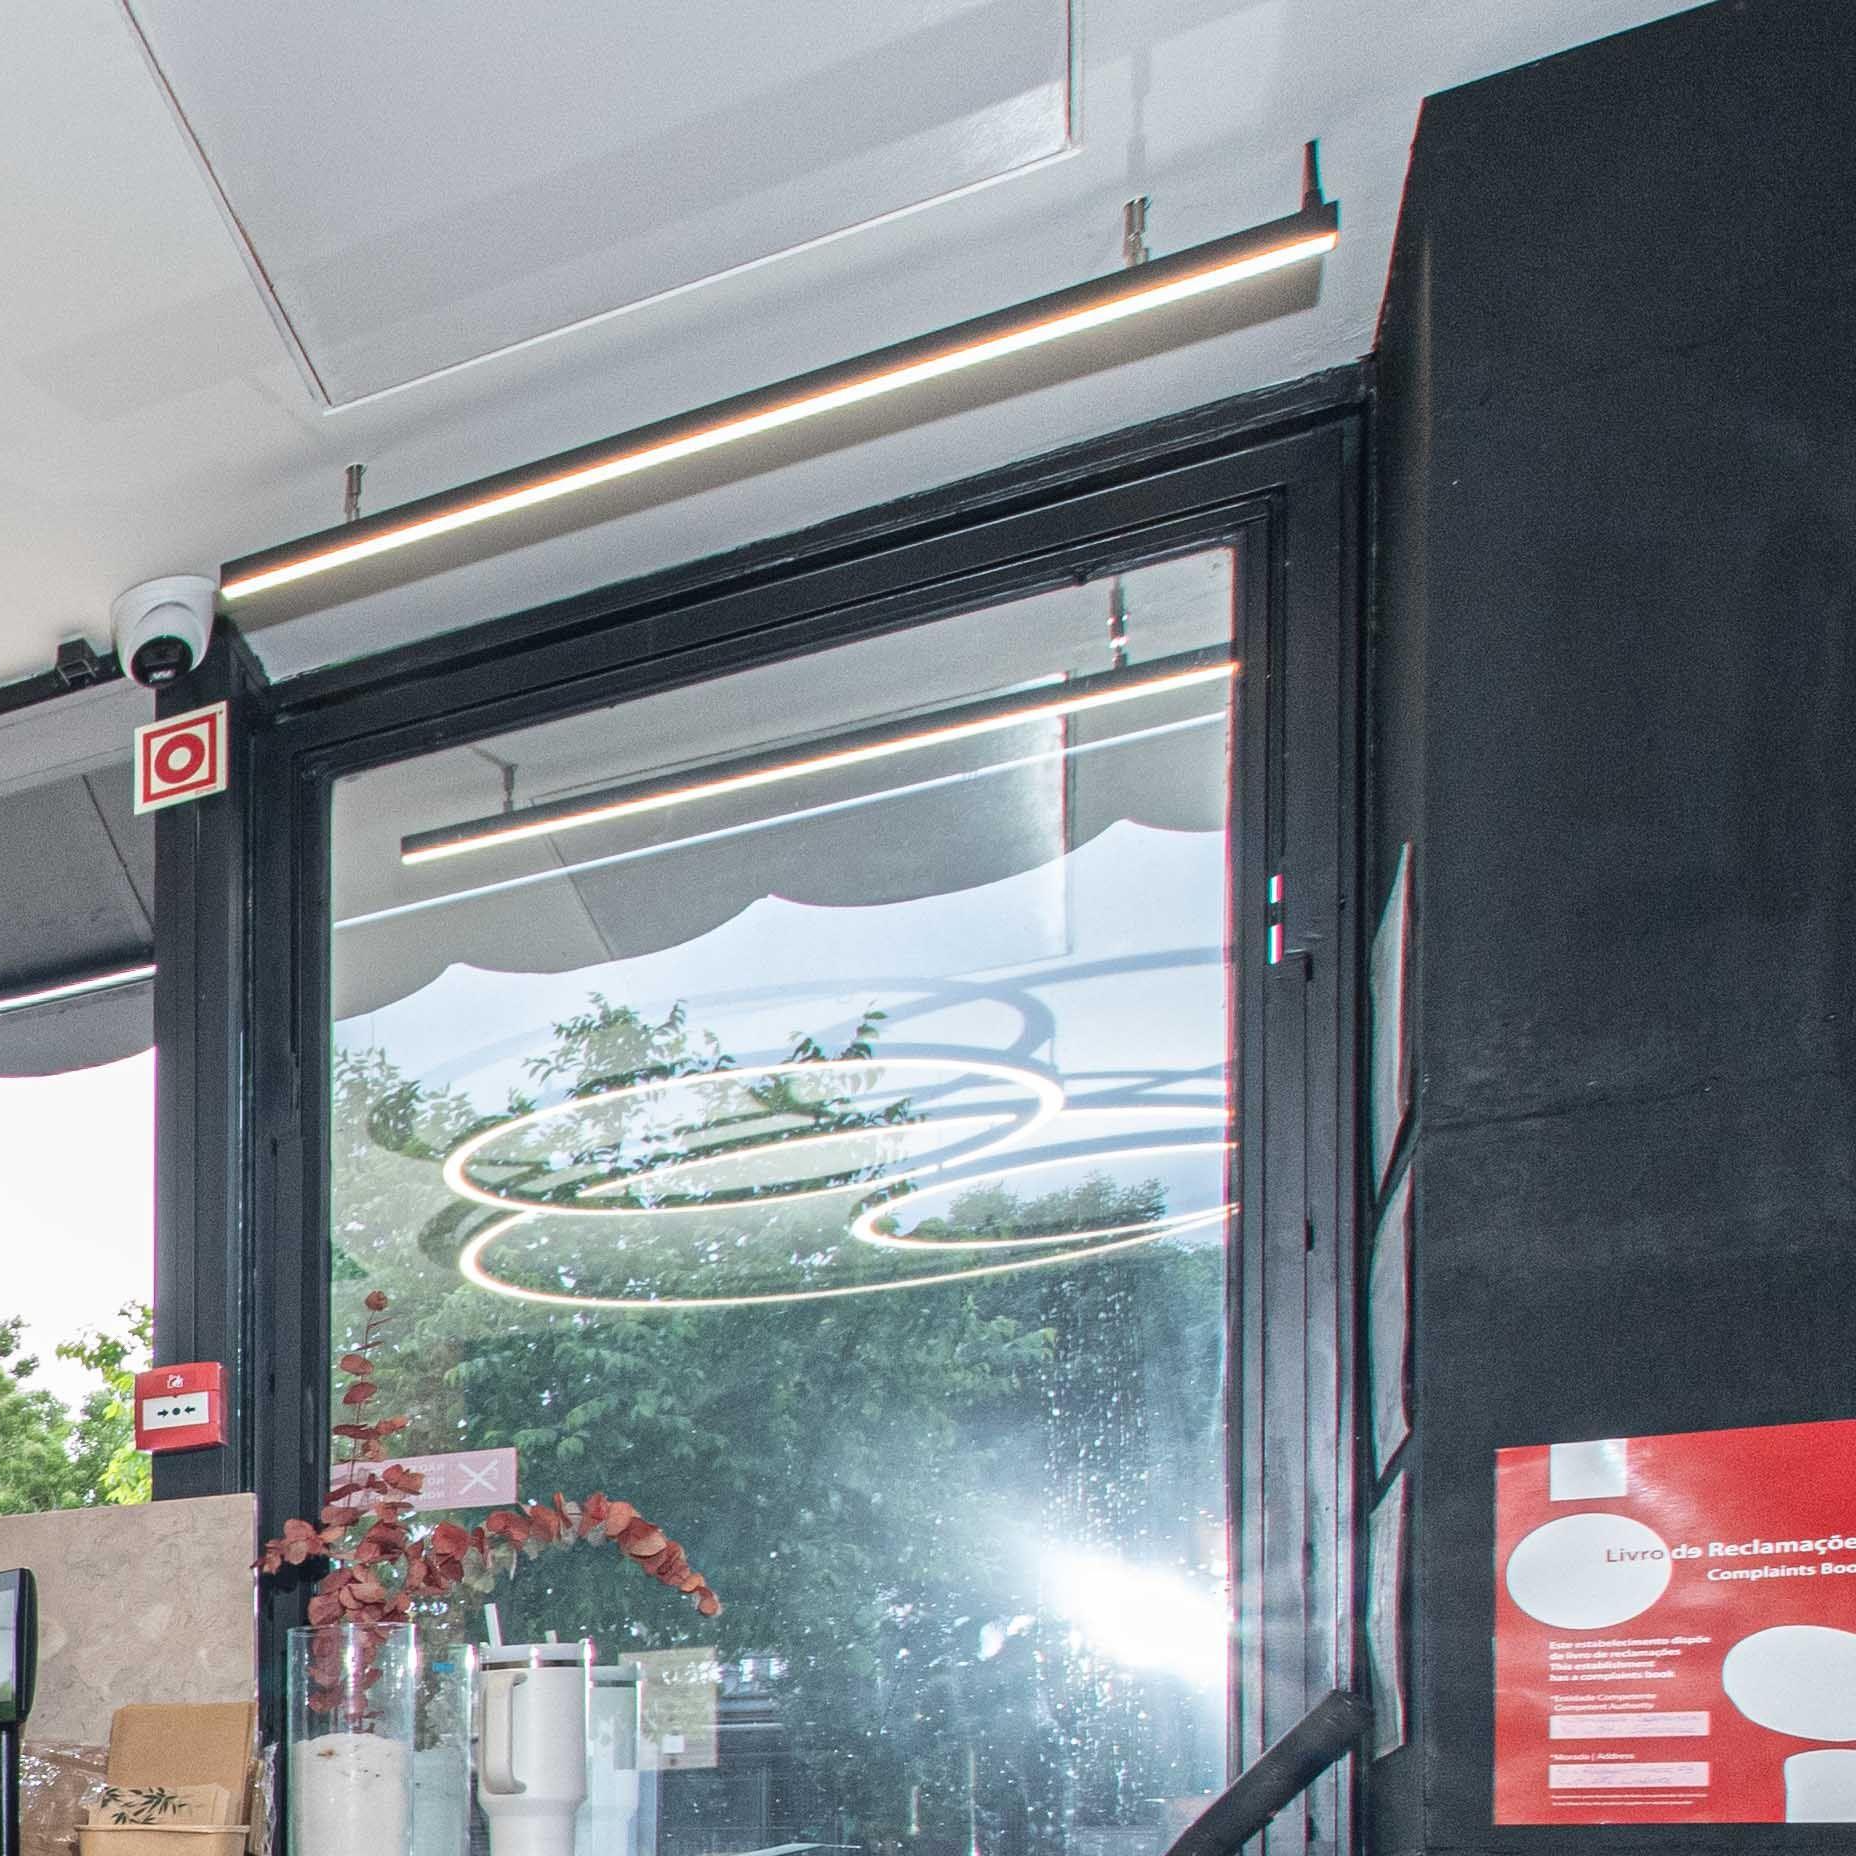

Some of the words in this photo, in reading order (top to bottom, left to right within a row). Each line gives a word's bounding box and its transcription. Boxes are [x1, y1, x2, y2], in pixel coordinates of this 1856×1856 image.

[1606, 1548, 1664, 1563] Livro
[1671, 1544, 1703, 1560] de
[1708, 1534, 1856, 1558] Reclamaçõe
[1707, 1564, 1817, 1582] Complaints
[1821, 1562, 1856, 1576] Boo
